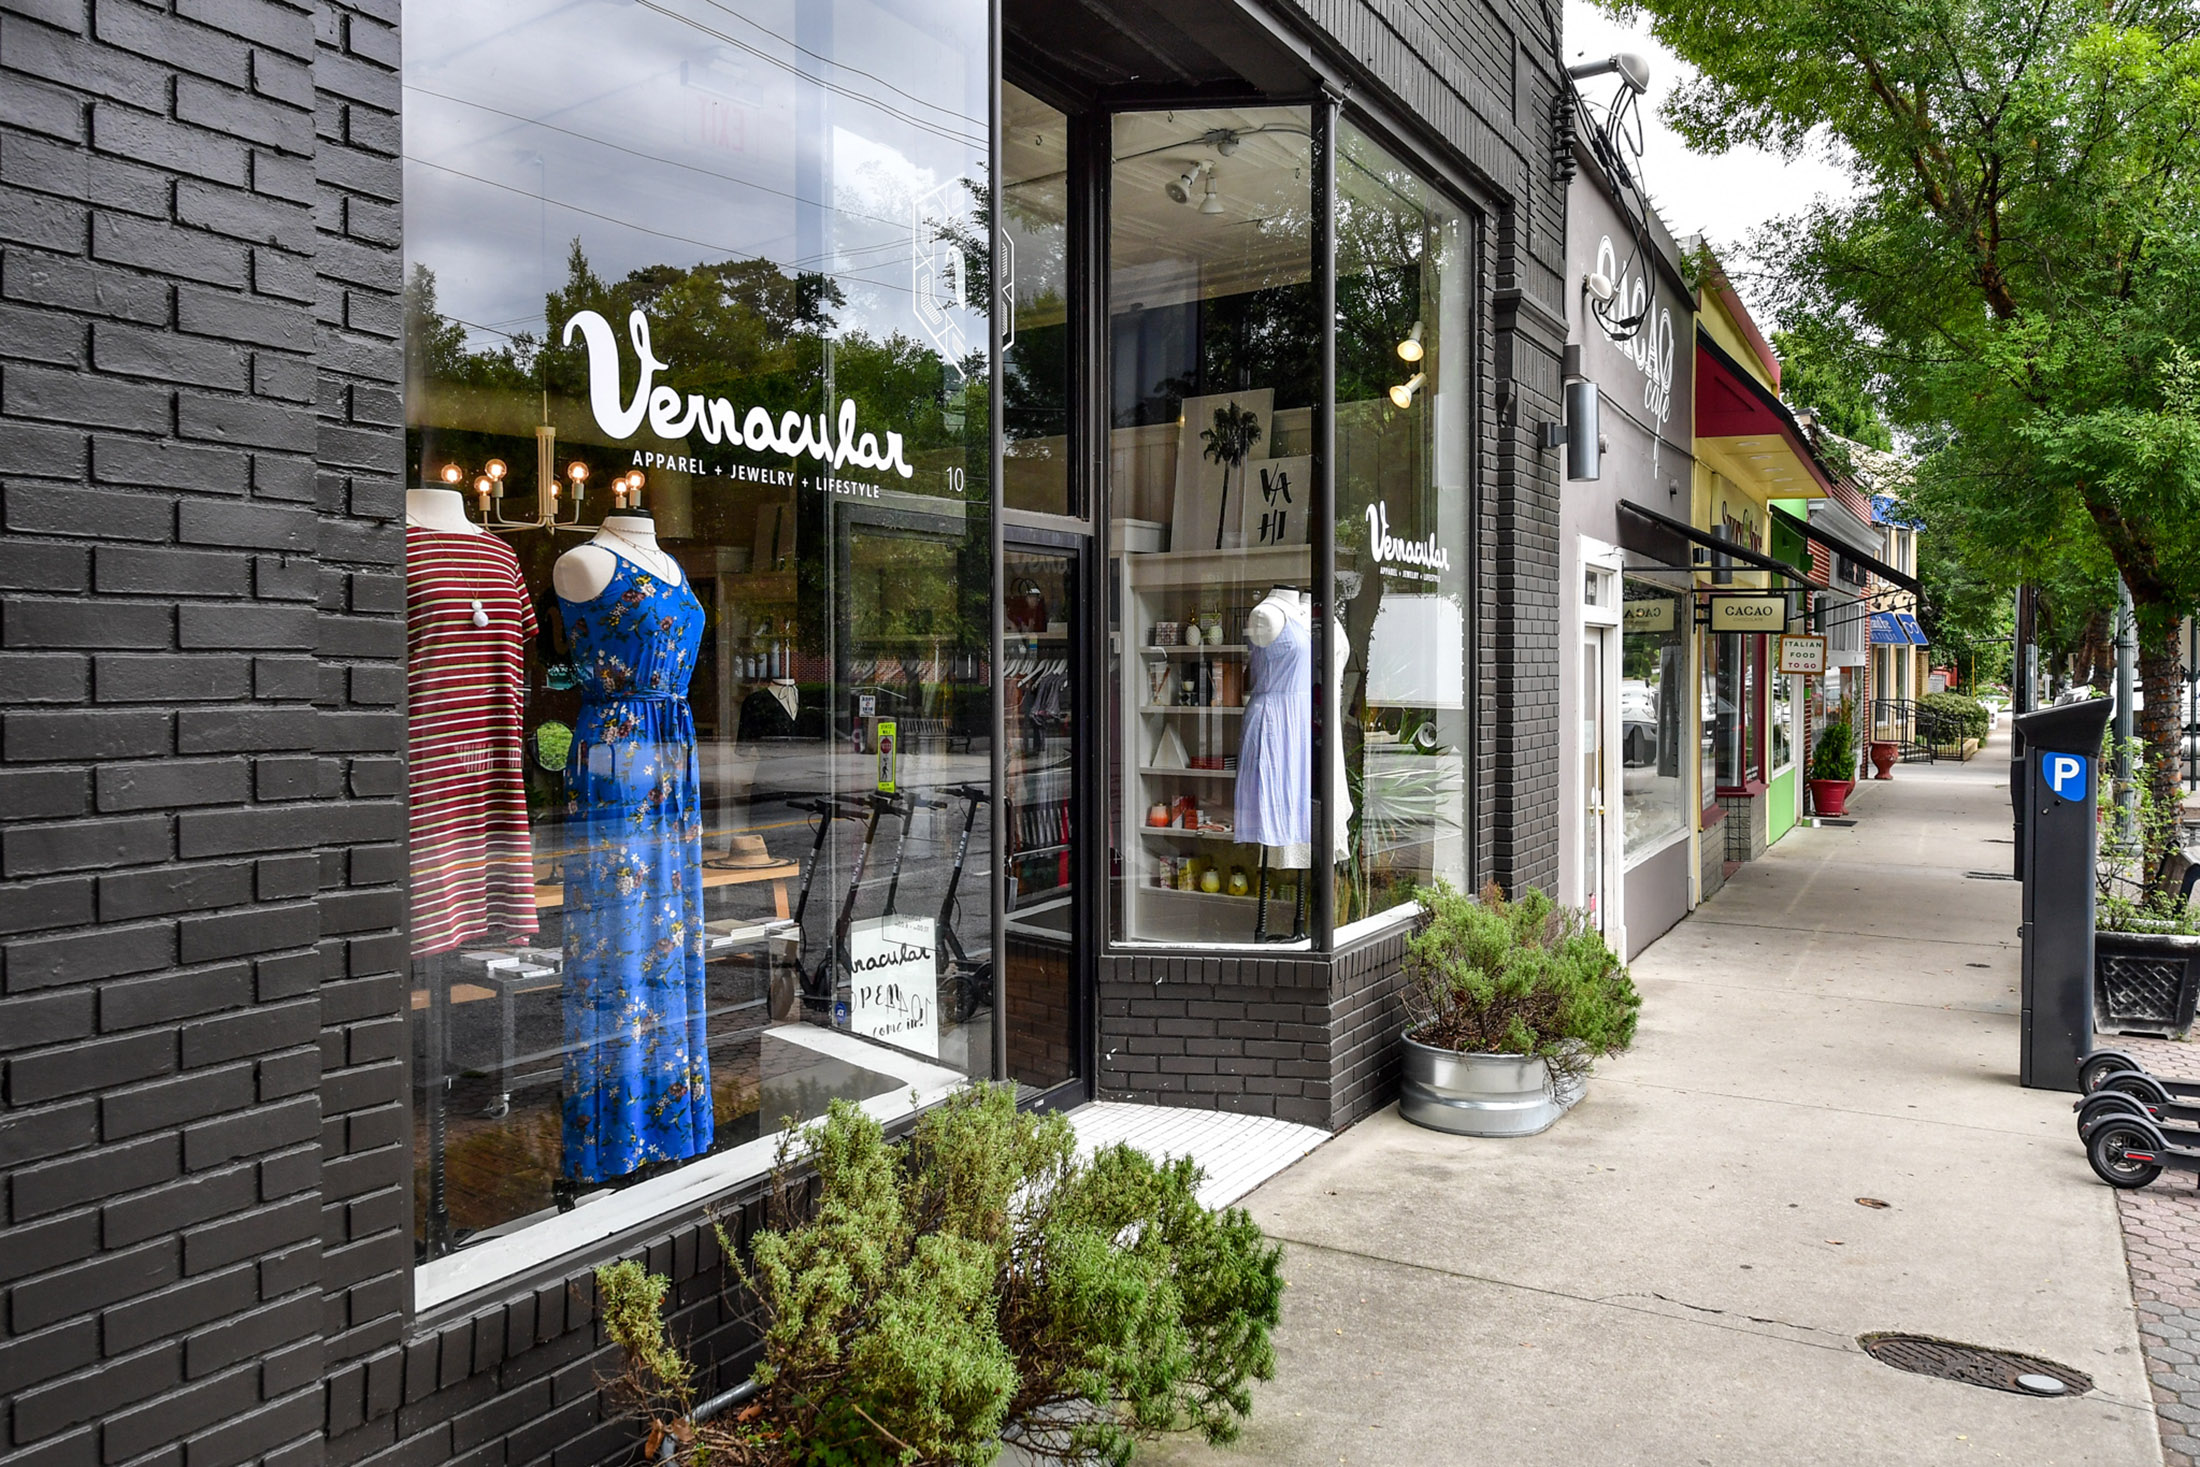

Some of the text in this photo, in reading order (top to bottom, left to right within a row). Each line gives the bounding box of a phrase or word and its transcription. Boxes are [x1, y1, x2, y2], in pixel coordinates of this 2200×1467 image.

[1596, 235, 1675, 394] CACAO
[562, 309, 914, 479] Vernacular
[632, 450, 707, 476] APPAREL
[730, 464, 796, 488] JEWELRY
[816, 476, 880, 499] LIFESTYLE
[946, 466, 965, 493] 10
[1260, 463, 1292, 507] VA
[1257, 509, 1287, 546] HI
[1365, 500, 1450, 572] Vernacular
[1724, 606, 1773, 616] CACAO
[1790, 651, 1816, 659] FOOD
[2054, 757, 2080, 791] P
[851, 943, 931, 974] nacular
[851, 983, 900, 1014] PEN
